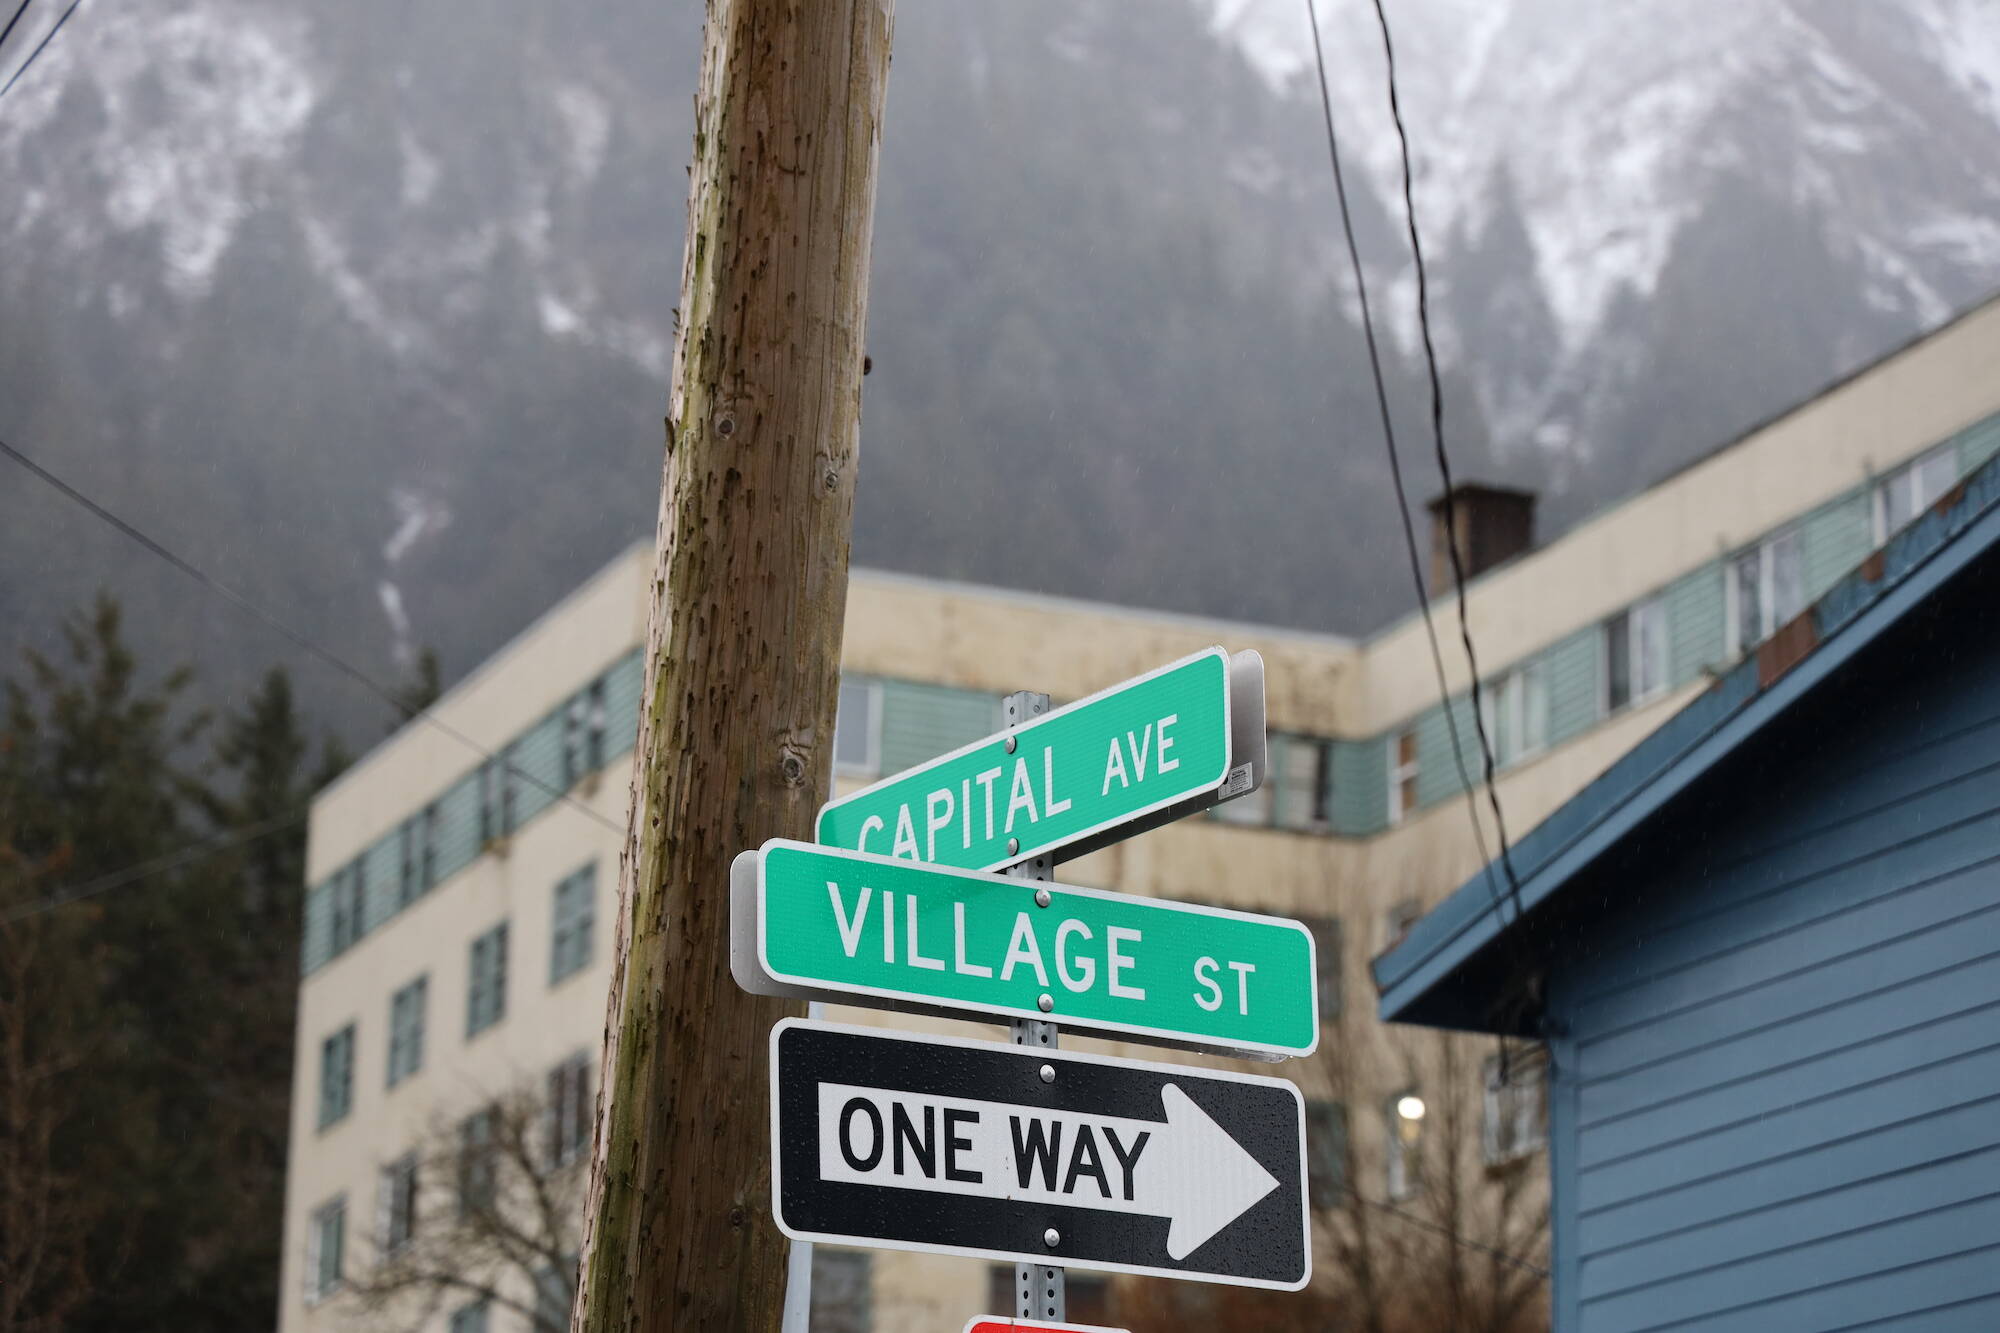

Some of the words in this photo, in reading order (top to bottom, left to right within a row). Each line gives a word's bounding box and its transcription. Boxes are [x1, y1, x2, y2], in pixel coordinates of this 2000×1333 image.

[857, 747, 1071, 862] CAPITAL
[1102, 714, 1179, 796] AVE
[827, 881, 1146, 999] VILLAGE
[1193, 956, 1256, 1015] ST
[838, 1097, 983, 1184] ONE
[1009, 1115, 1151, 1201] WAY
